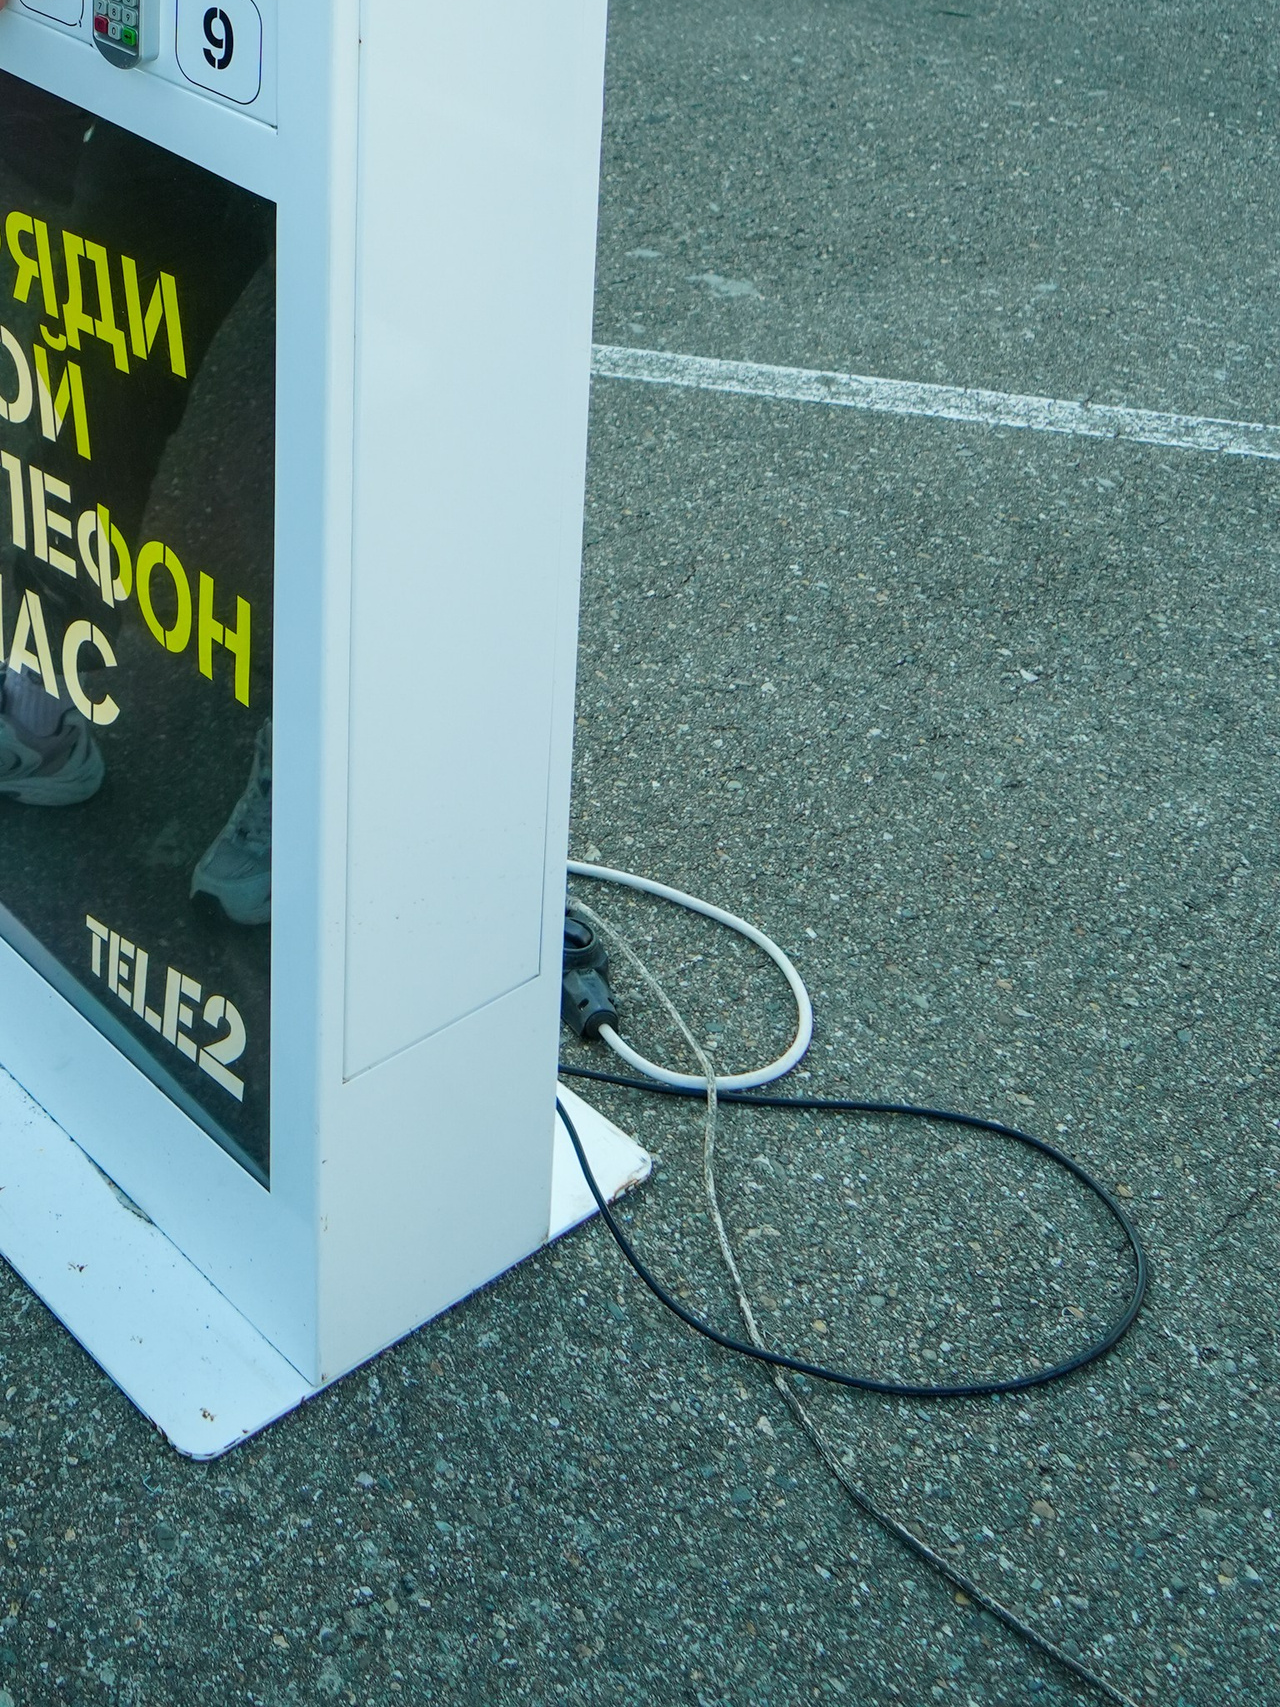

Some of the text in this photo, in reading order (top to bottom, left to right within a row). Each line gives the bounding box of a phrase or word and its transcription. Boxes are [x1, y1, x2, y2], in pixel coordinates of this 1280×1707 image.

[112, 27, 116, 35] 0
[203, 6, 234, 70] 9
[86, 913, 246, 1103] TELE2
